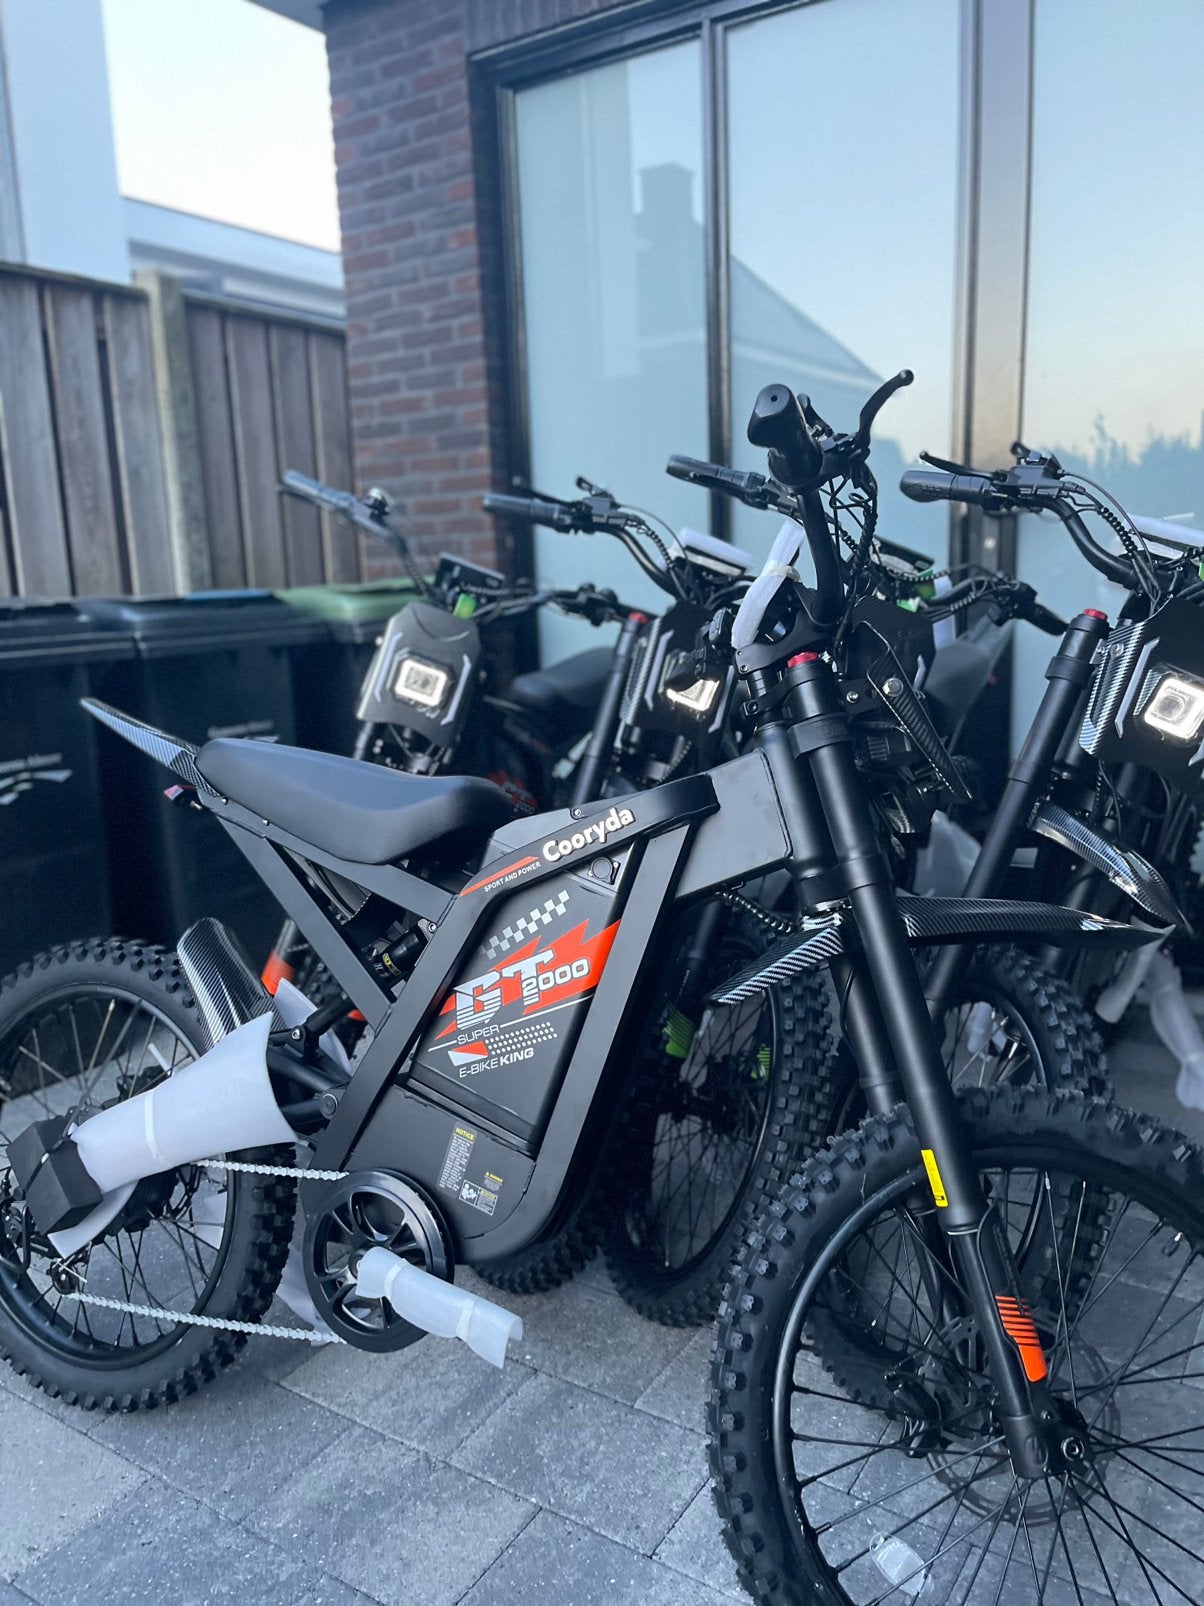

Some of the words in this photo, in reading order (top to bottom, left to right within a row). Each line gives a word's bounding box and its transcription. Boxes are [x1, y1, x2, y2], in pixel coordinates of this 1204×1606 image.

[542, 807, 636, 862] Cooryda
[484, 877, 504, 892] SPORT
[504, 872, 518, 885] AND
[517, 861, 542, 878] POWER
[453, 949, 555, 1031] GT
[522, 958, 590, 997] 2000
[457, 1024, 500, 1045] SUPER
[459, 1058, 499, 1078] E-BIKE
[500, 1047, 535, 1066] KING
[455, 1127, 475, 1141] NOTICE
